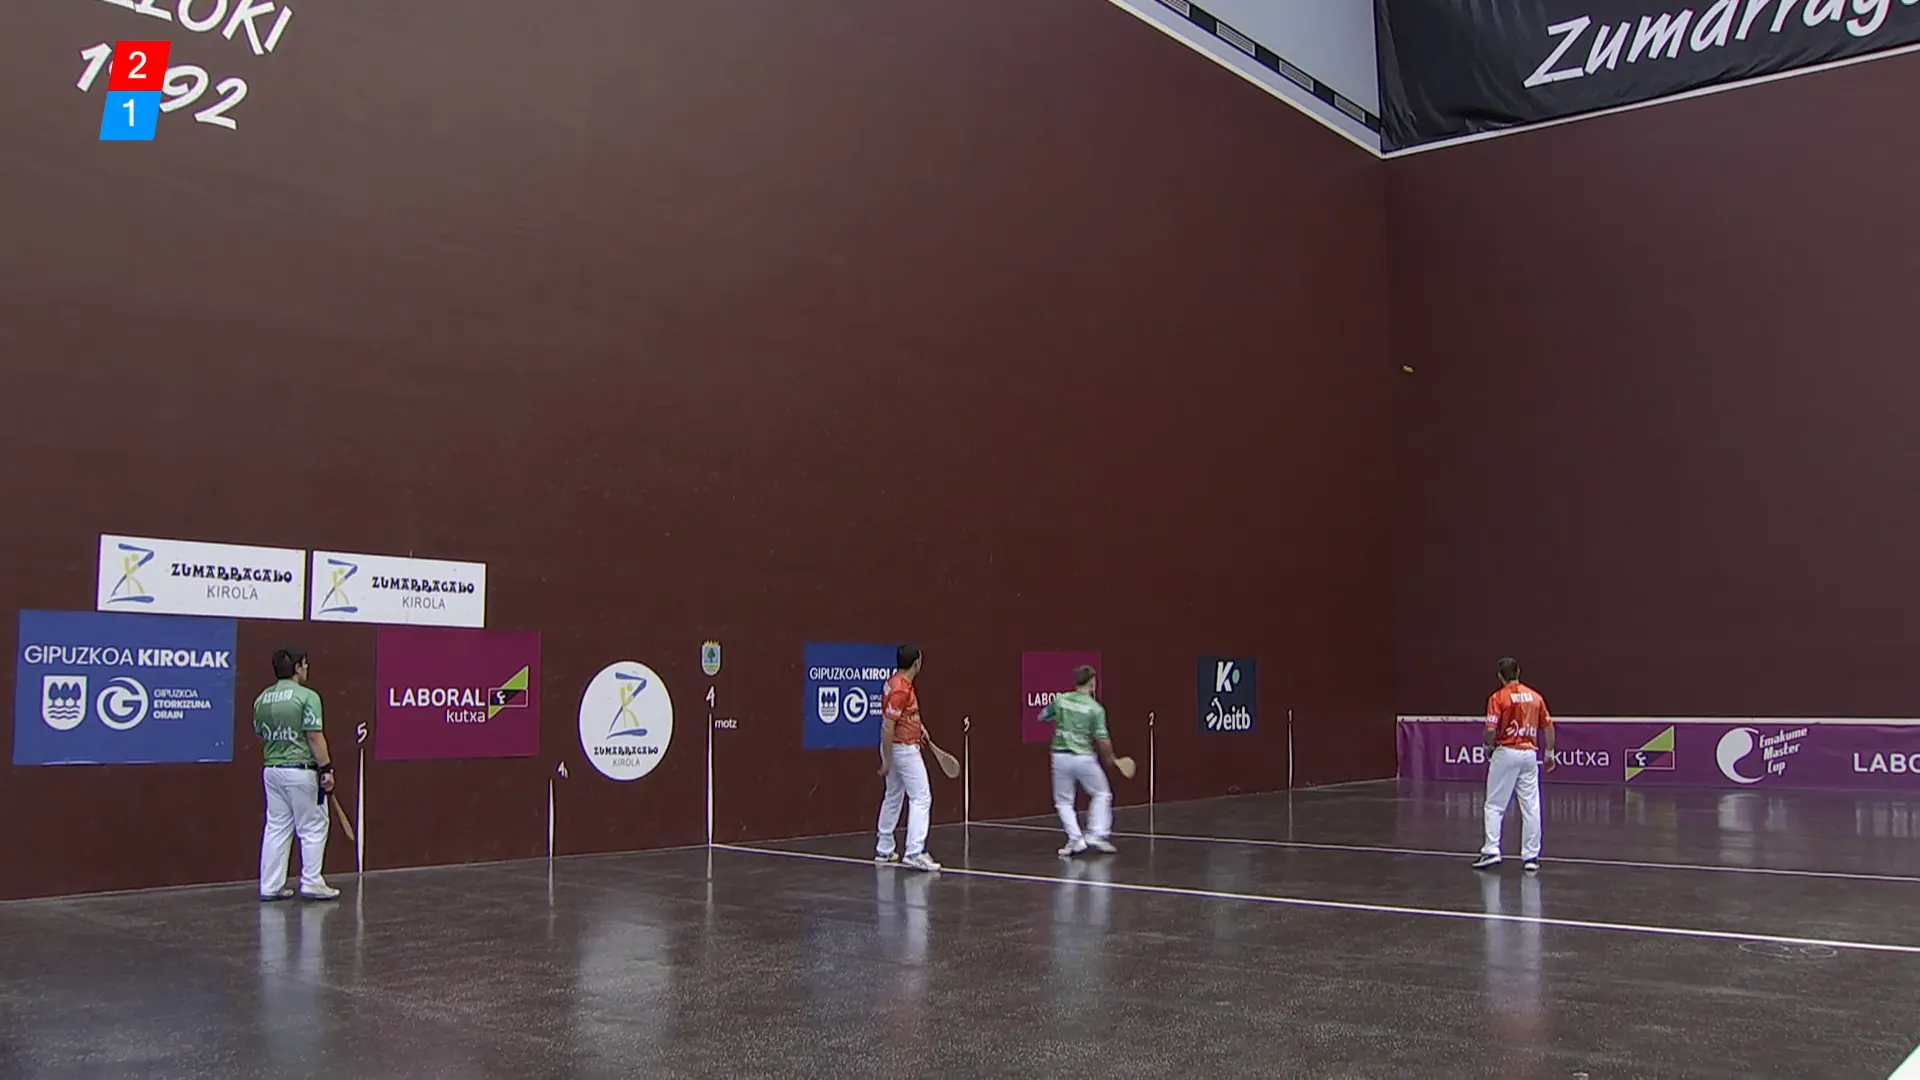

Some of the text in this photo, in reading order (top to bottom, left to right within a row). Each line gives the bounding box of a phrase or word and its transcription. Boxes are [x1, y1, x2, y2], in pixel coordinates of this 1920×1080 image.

[103, 0, 293, 55] OKI
[1523, 0, 1918, 88] Zumarrag
[77, 42, 248, 130] 192
[207, 585, 259, 600] KIROLA
[402, 597, 446, 610] KIROLA
[24, 645, 230, 668] GIPUZKOA KIROLAK
[809, 667, 861, 681] GIPUZKOA
[153, 689, 198, 698] GIPUZKOA
[389, 688, 486, 706] LABORAL
[706, 686, 715, 708] 4
[153, 710, 183, 719] ORAIN
[446, 710, 486, 723] kutxa
[1149, 712, 1155, 726] 2
[1223, 706, 1251, 730] eitb
[357, 722, 367, 743] 5
[714, 719, 737, 729] motz
[1759, 728, 1808, 748] Emakume
[1763, 742, 1801, 761] Master
[612, 758, 641, 768] KIROLA
[1767, 760, 1786, 776] Cup
